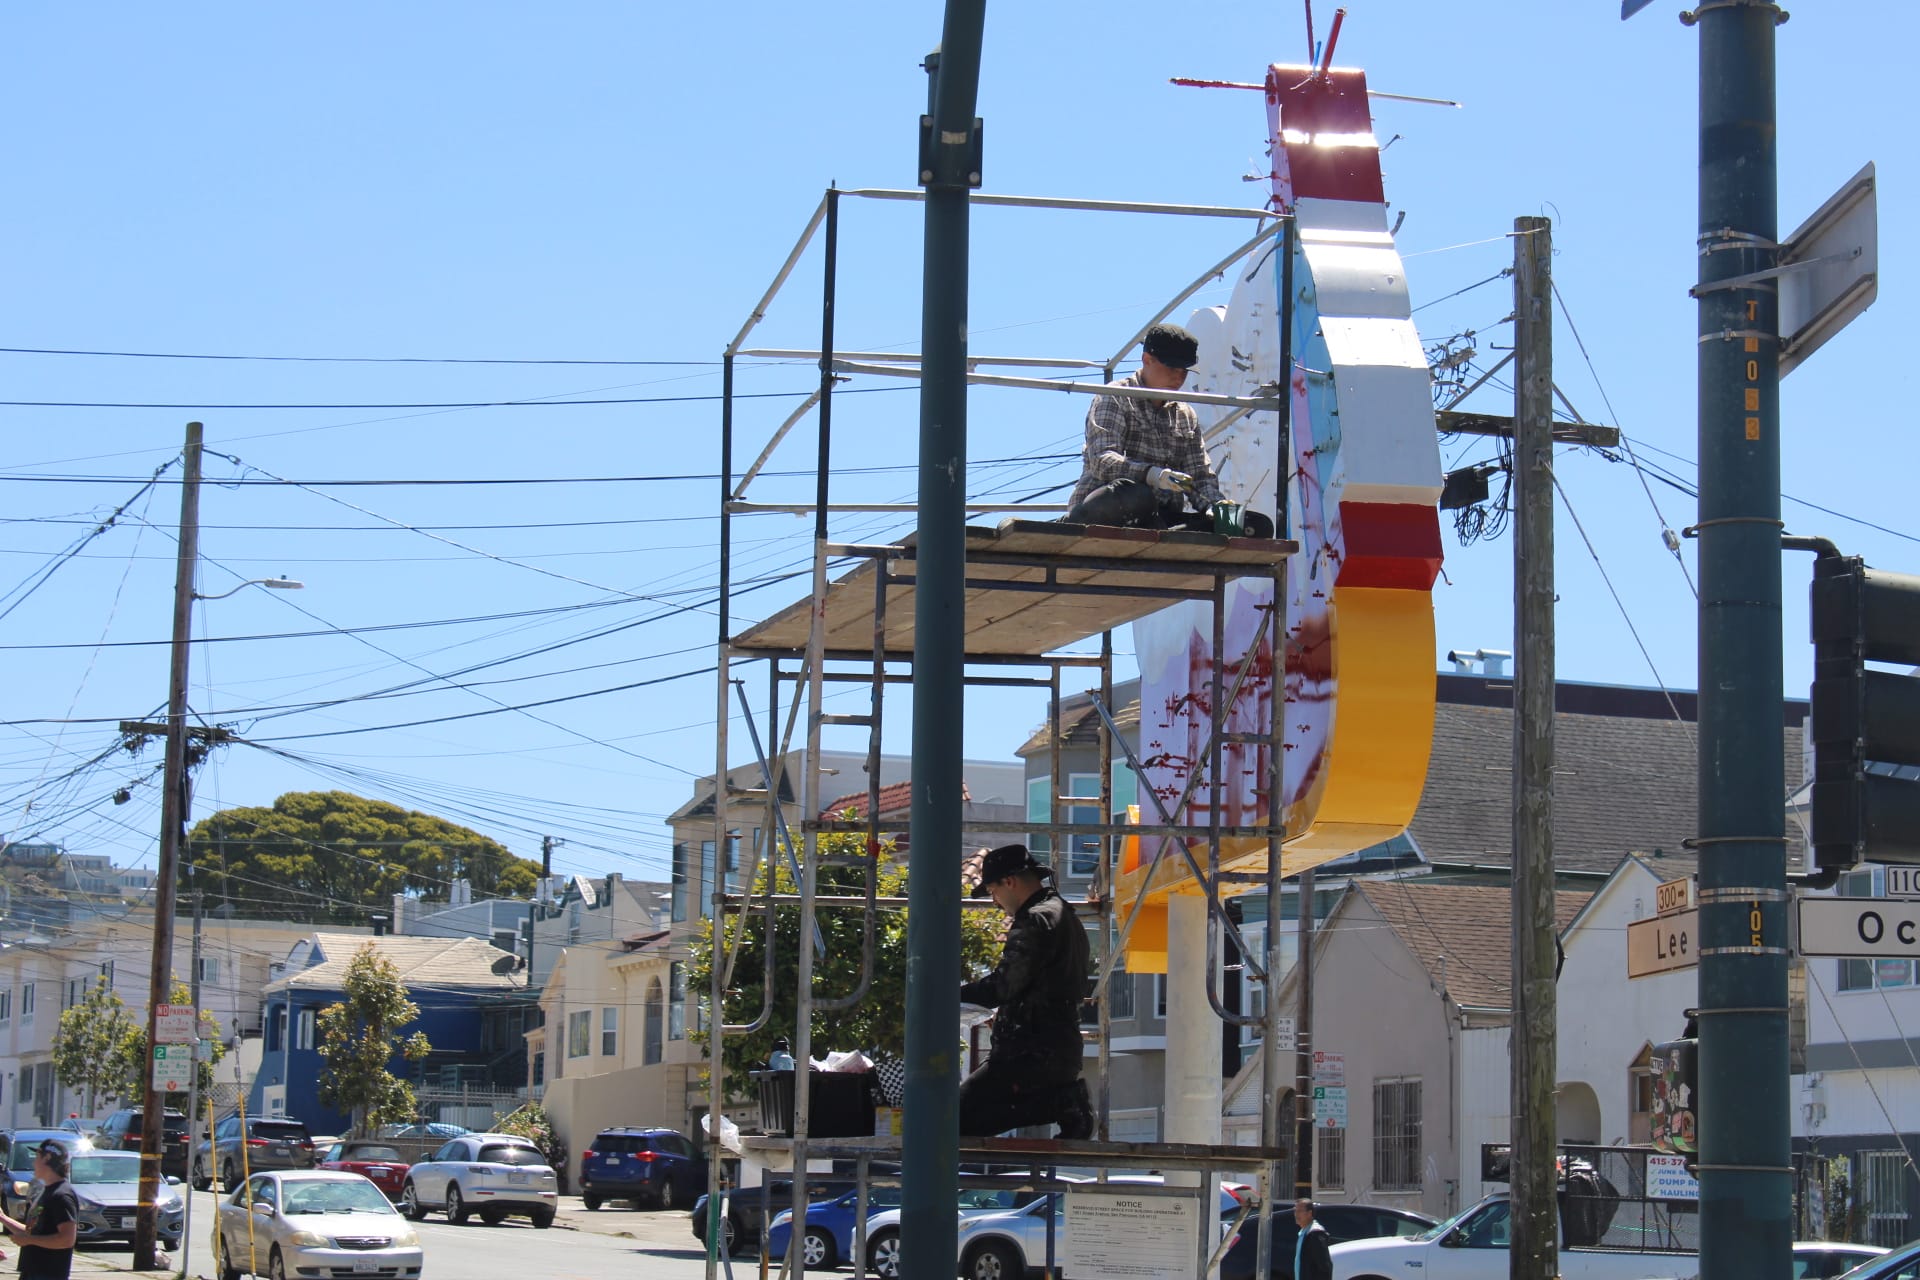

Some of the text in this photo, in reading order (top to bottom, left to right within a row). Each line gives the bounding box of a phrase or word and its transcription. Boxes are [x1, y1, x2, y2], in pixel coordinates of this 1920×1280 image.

[1659, 885, 1676, 910] 300
[1657, 929, 1687, 960] Lee
[157, 1006, 193, 1016] NO PARKING
[156, 1048, 164, 1058] 2
[1316, 1088, 1323, 1097] 2
[1116, 1200, 1143, 1208] NOTICE
